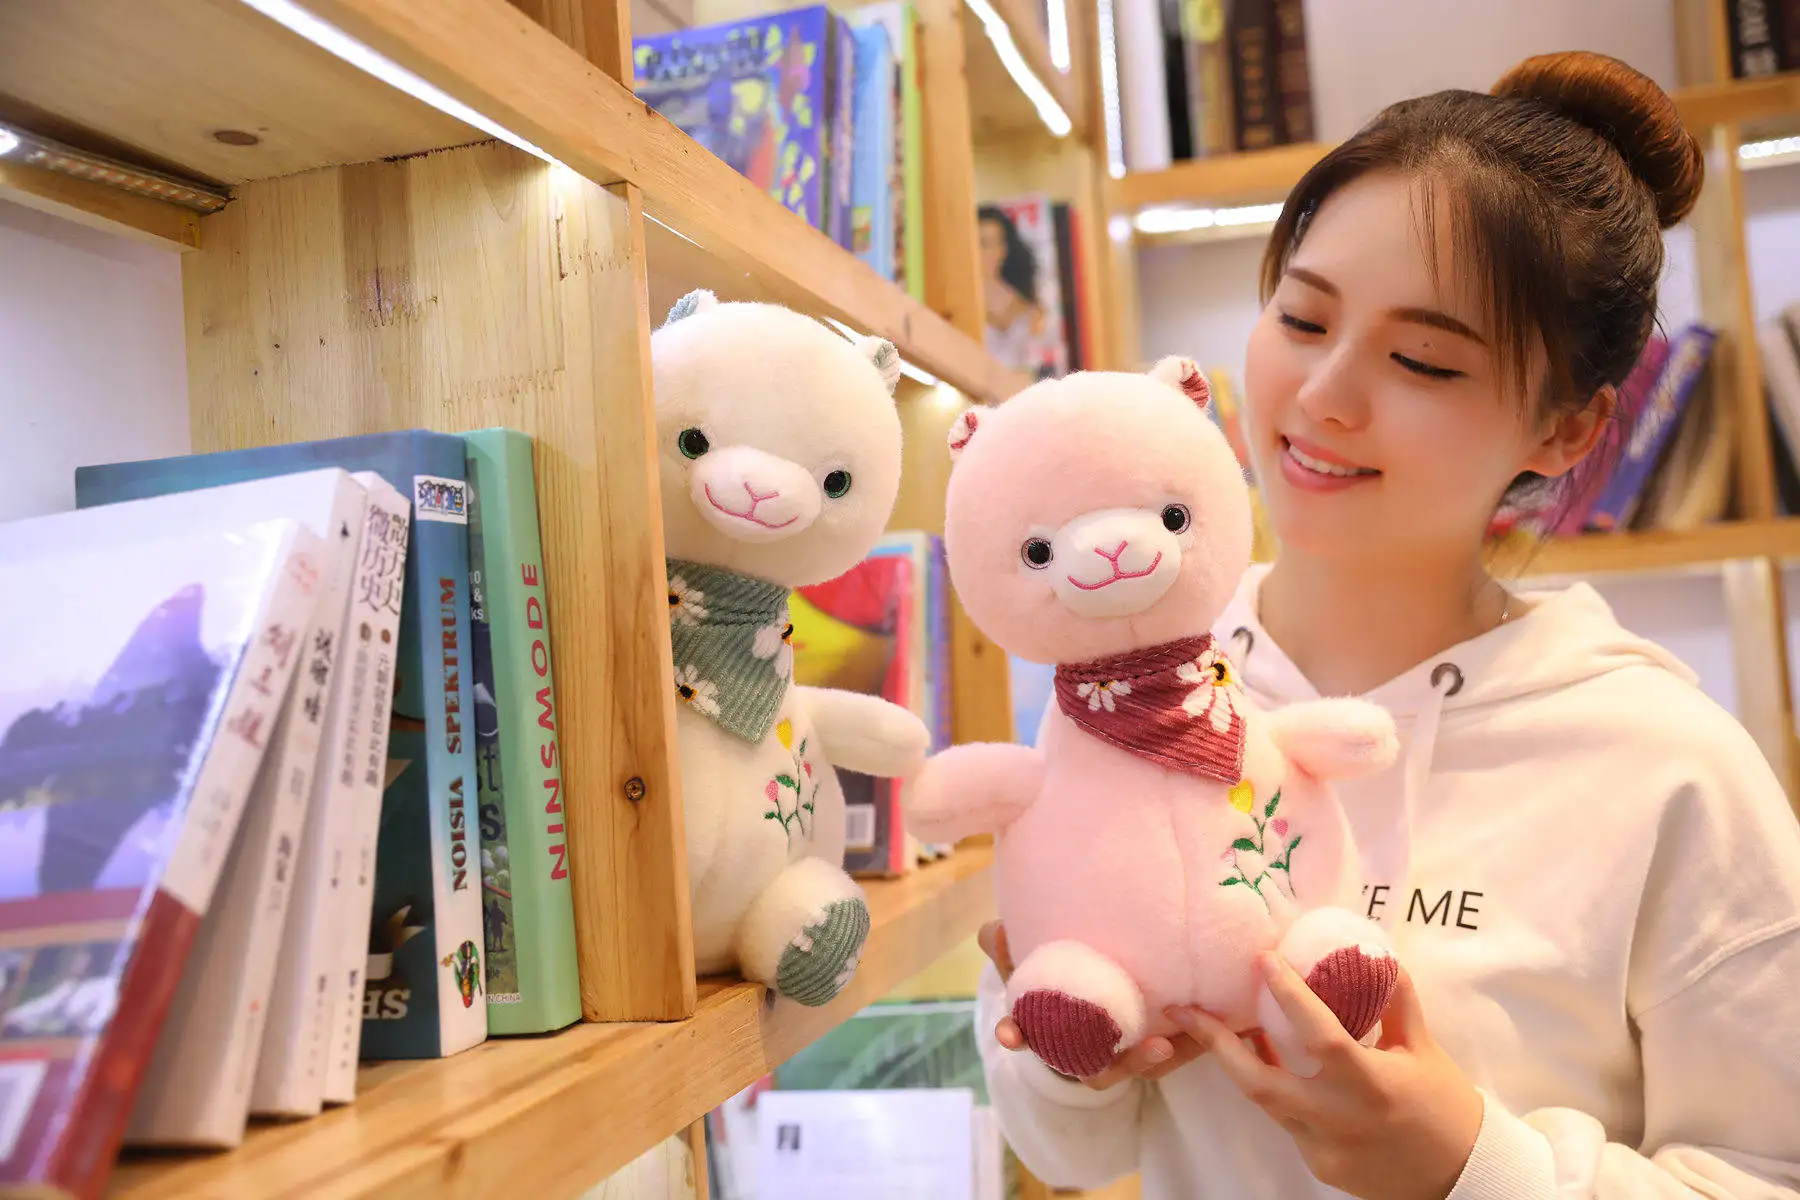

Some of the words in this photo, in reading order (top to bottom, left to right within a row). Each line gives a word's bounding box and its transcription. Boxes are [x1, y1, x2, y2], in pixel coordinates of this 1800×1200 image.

[439, 576, 462, 755] SPEKTRUM
[521, 563, 567, 880] NINSMODE
[1361, 884, 1390, 921] E
[1406, 888, 1484, 930] ME
